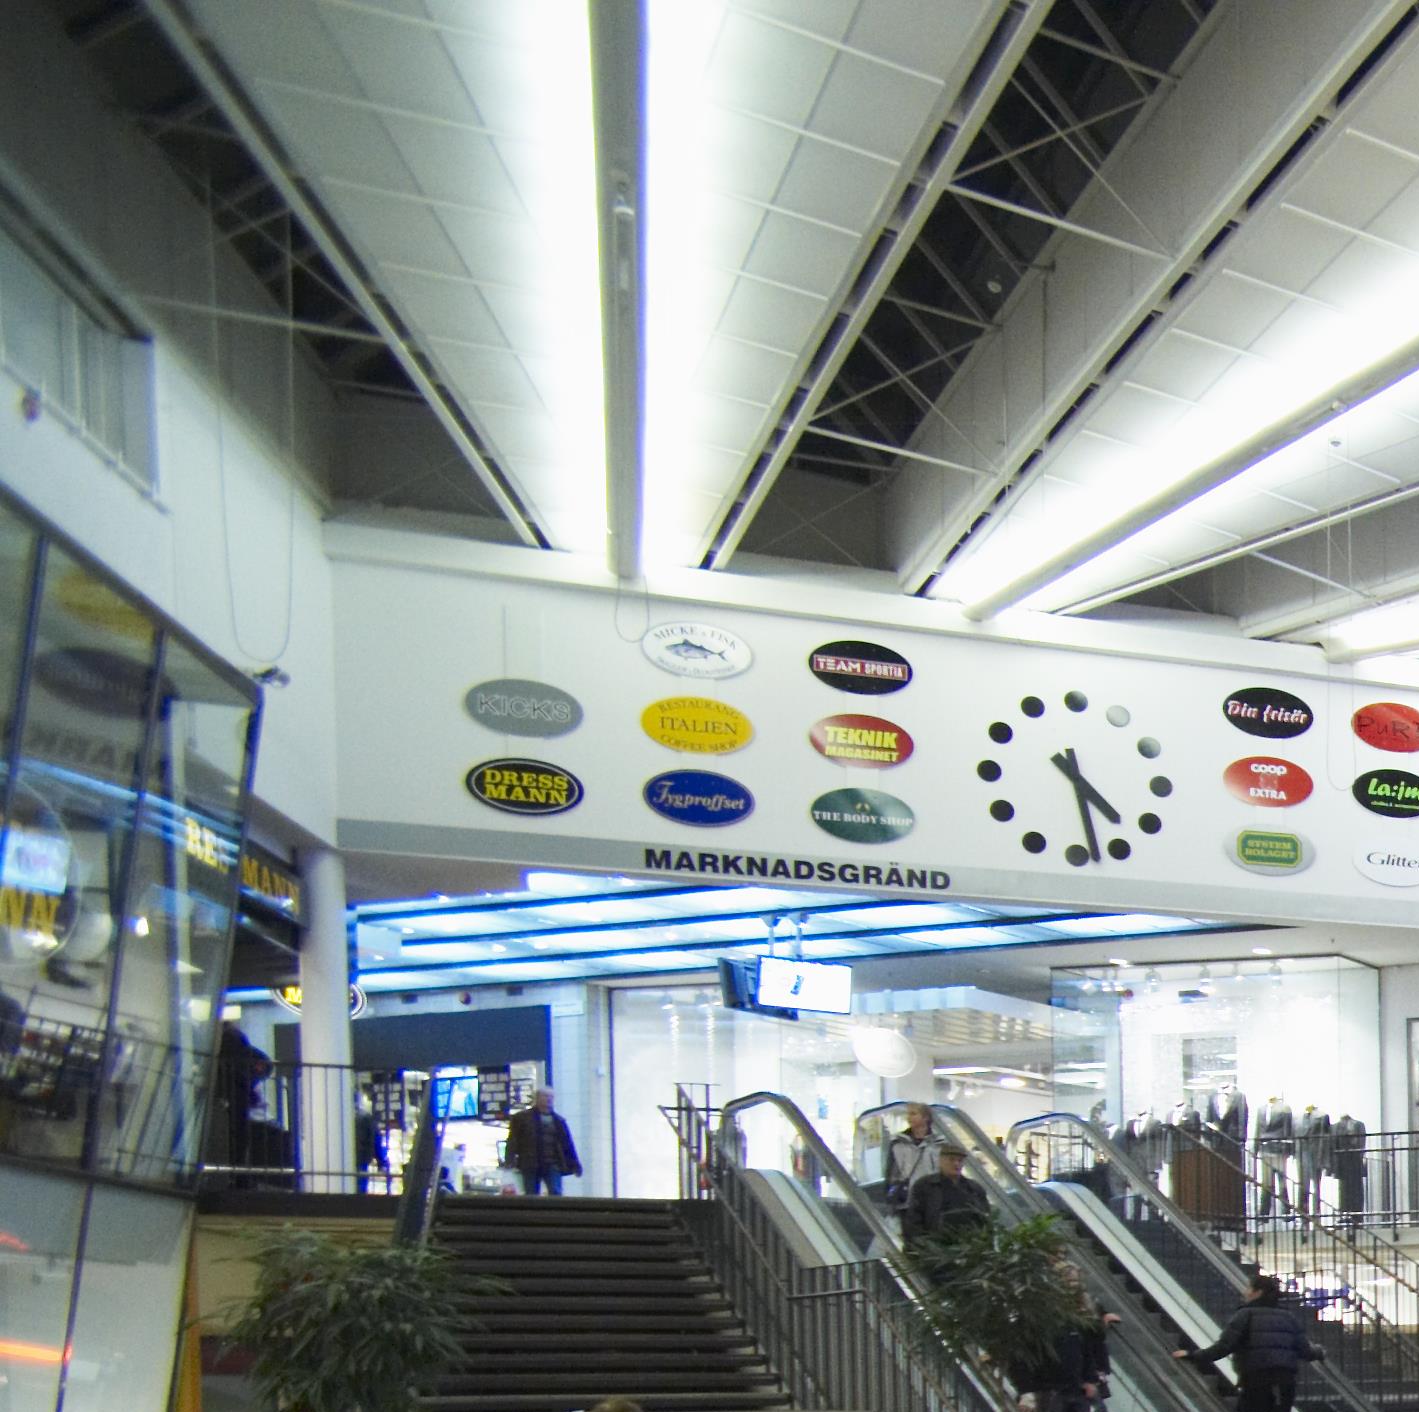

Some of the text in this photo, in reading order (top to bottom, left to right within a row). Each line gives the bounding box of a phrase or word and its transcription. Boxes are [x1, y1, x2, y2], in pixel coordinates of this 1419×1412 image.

[816, 656, 903, 678] TEAM SPORTIA
[477, 692, 571, 723] KICKS
[1227, 699, 1259, 719] Din
[660, 716, 738, 736] ITALIEN
[660, 735, 706, 751] COFFEE
[825, 726, 898, 749] TEKNIK
[825, 744, 899, 762] MAGASINET
[483, 768, 570, 790] DRESS
[484, 784, 570, 806] MANN
[652, 780, 745, 812] Tygproffset
[1249, 787, 1287, 800] EXTRA
[813, 809, 914, 827] THE BODY SHOP
[1245, 847, 1296, 859] BOLAGET
[1247, 840, 1291, 850] SYSTEM
[644, 848, 951, 890] MARKNADSGRÄND
